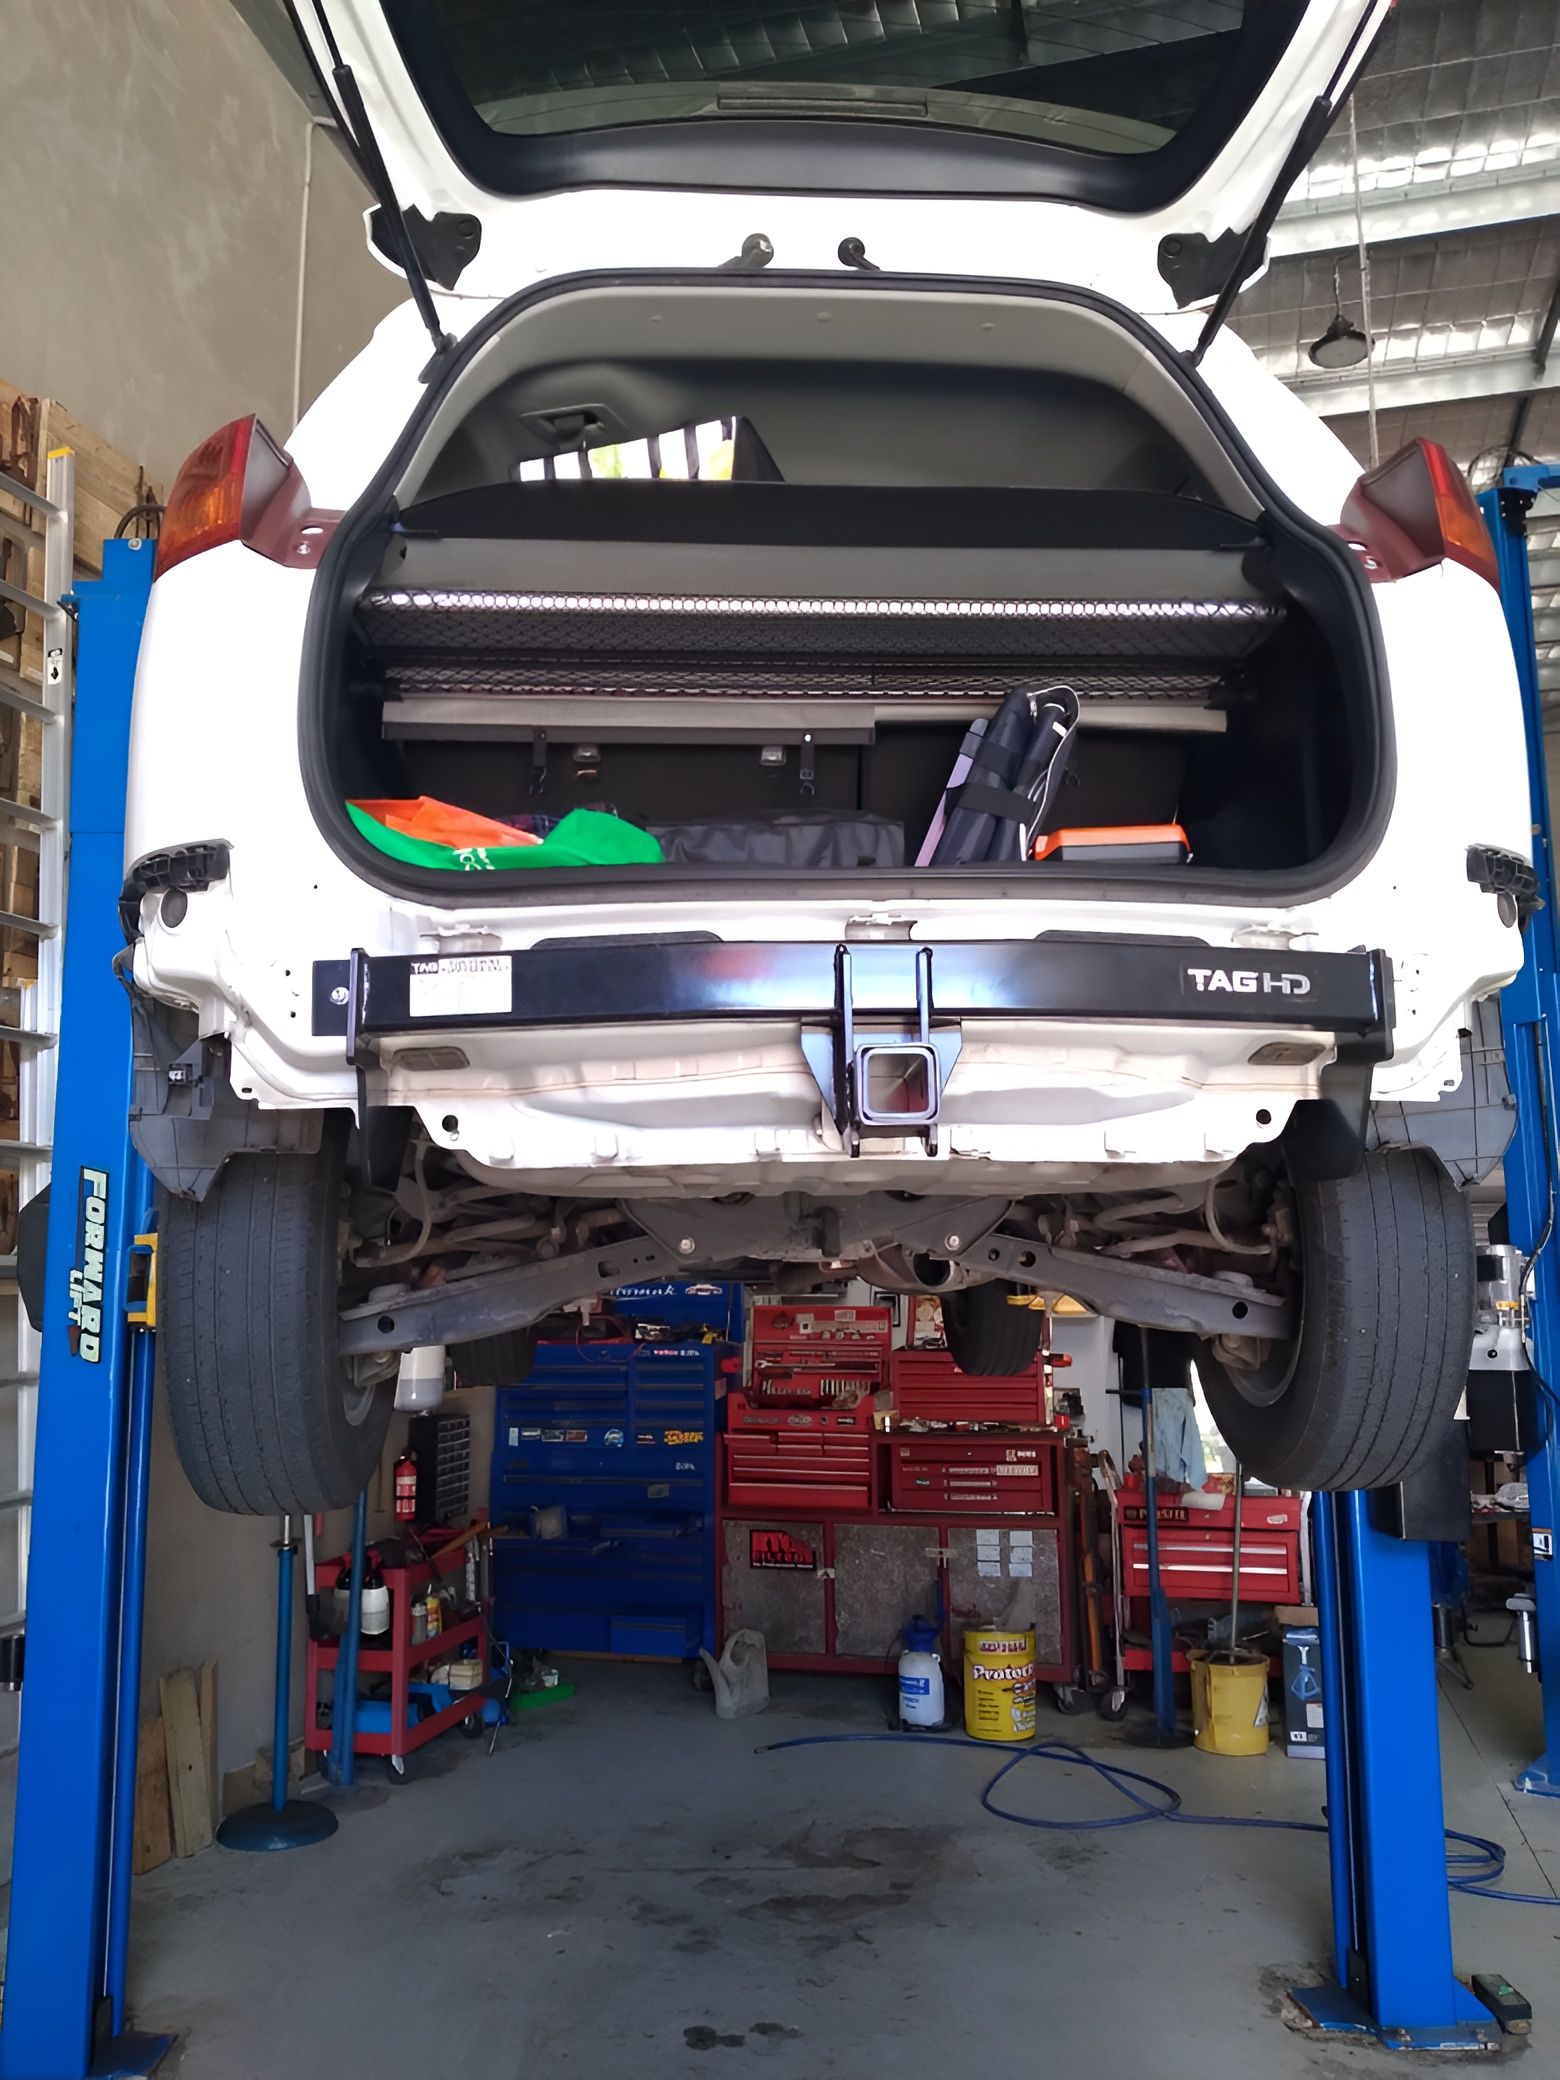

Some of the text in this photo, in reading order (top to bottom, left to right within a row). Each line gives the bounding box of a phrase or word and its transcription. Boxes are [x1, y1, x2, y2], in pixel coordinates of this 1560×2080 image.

[1187, 968, 1312, 995] TAG HD
[80, 1167, 108, 1363] FORWARD
[68, 1269, 83, 1327] LIFT
